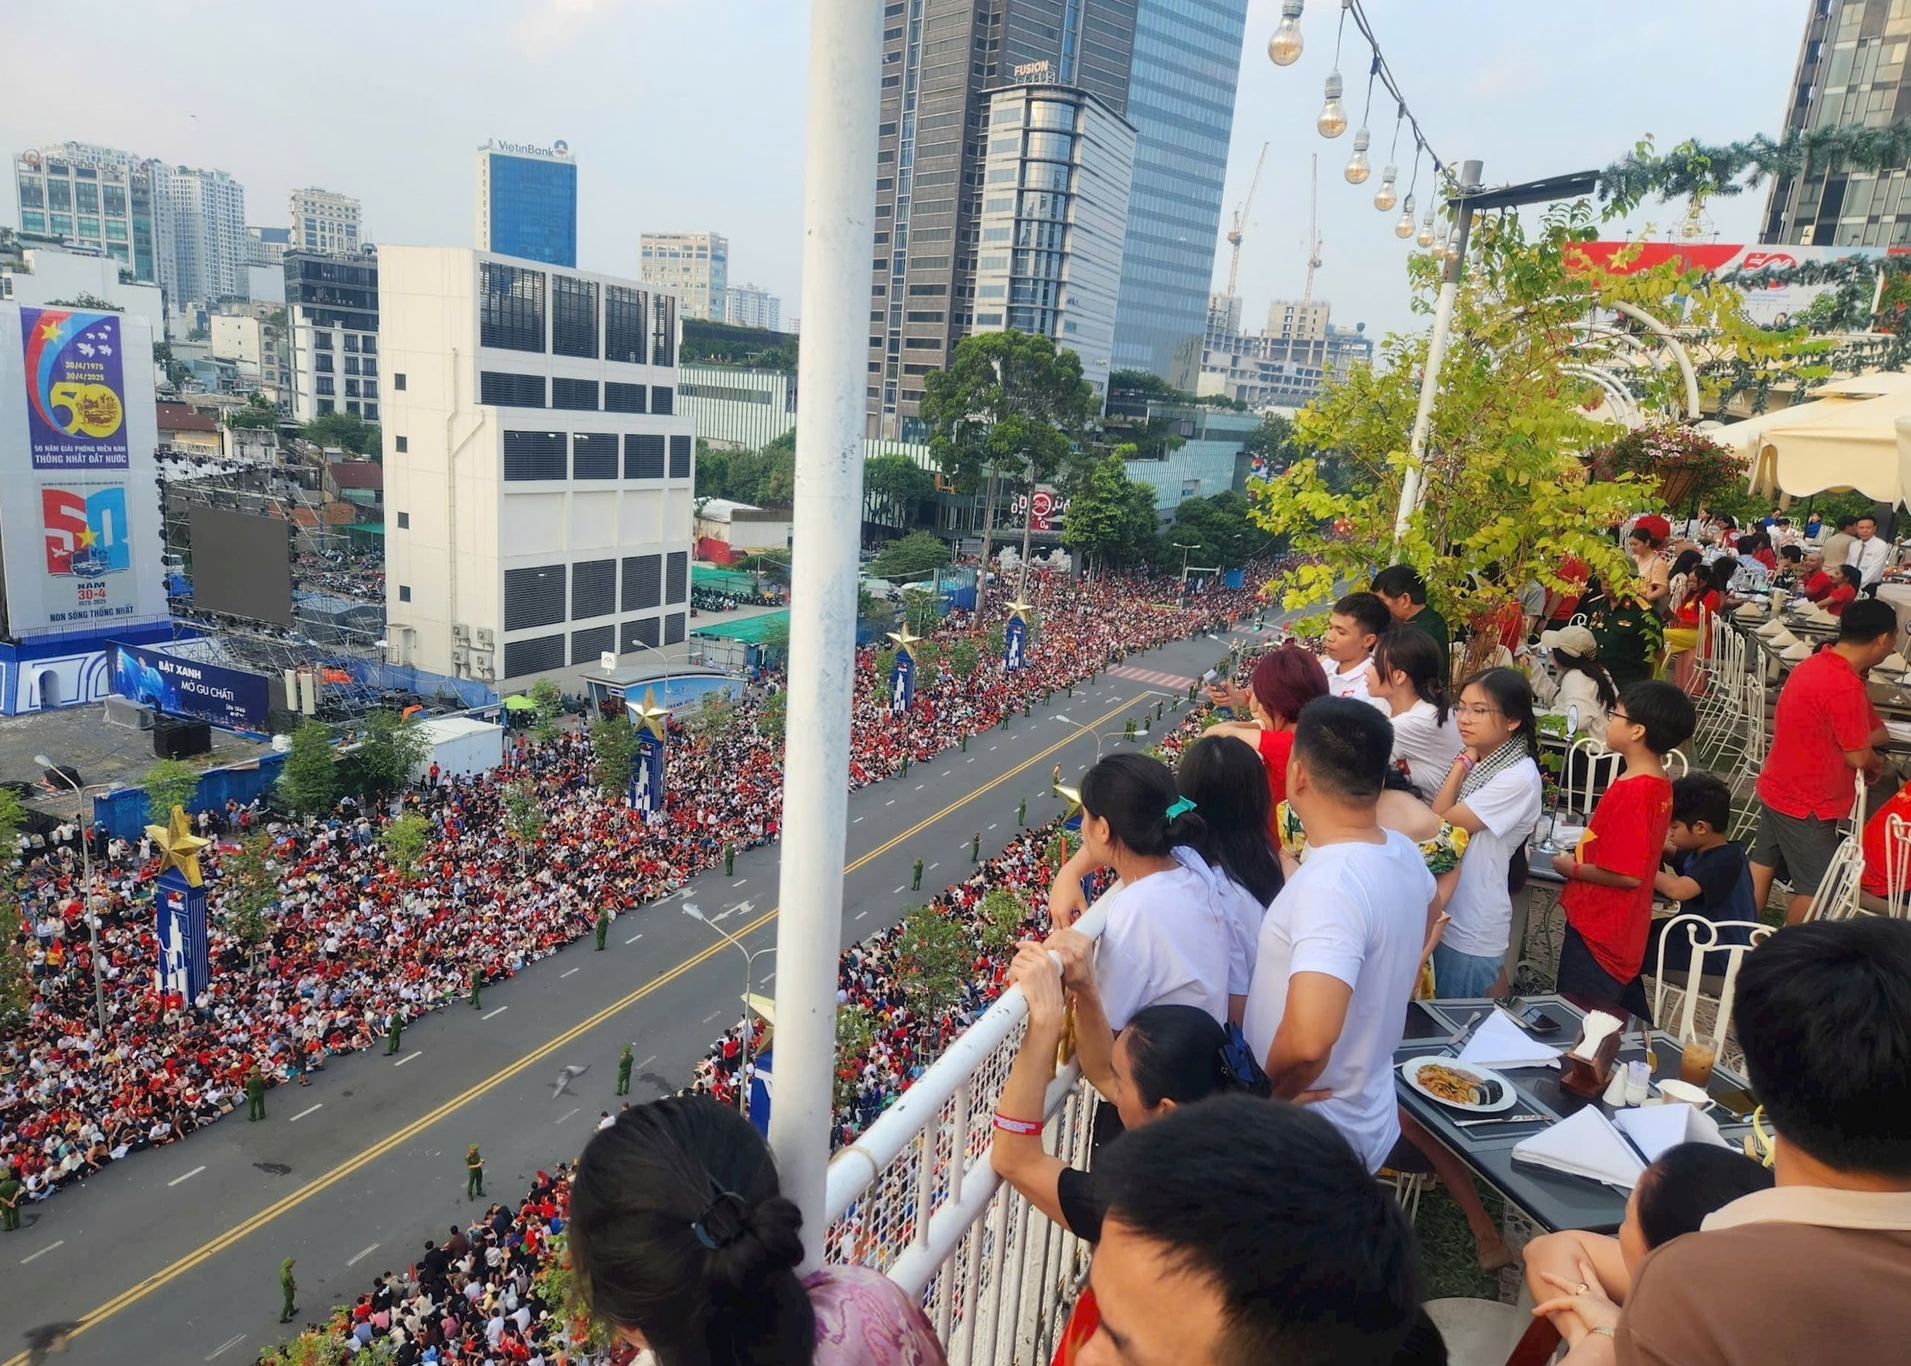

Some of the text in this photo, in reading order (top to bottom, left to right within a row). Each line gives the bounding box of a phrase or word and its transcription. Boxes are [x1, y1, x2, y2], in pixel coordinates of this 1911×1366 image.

[1014, 59, 1049, 77] FUSION
[498, 139, 554, 157] VietinBank
[46, 156, 95, 169] Hanwha
[65, 361, 104, 370] 30/4/1975
[66, 372, 104, 381] 30/4/2025
[50, 382, 123, 438] 50
[44, 444, 60, 452] NĂM
[112, 445, 126, 453] NAM
[35, 452, 127, 464] THỐNG NHẤT ĐẤT NƯỚC
[78, 588, 106, 600] 30-4
[50, 613, 66, 622] NON
[90, 605, 114, 618] THỐNG
[158, 660, 202, 680] BẬT XANH
[181, 679, 196, 693] MỞ
[196, 683, 209, 696] GU
